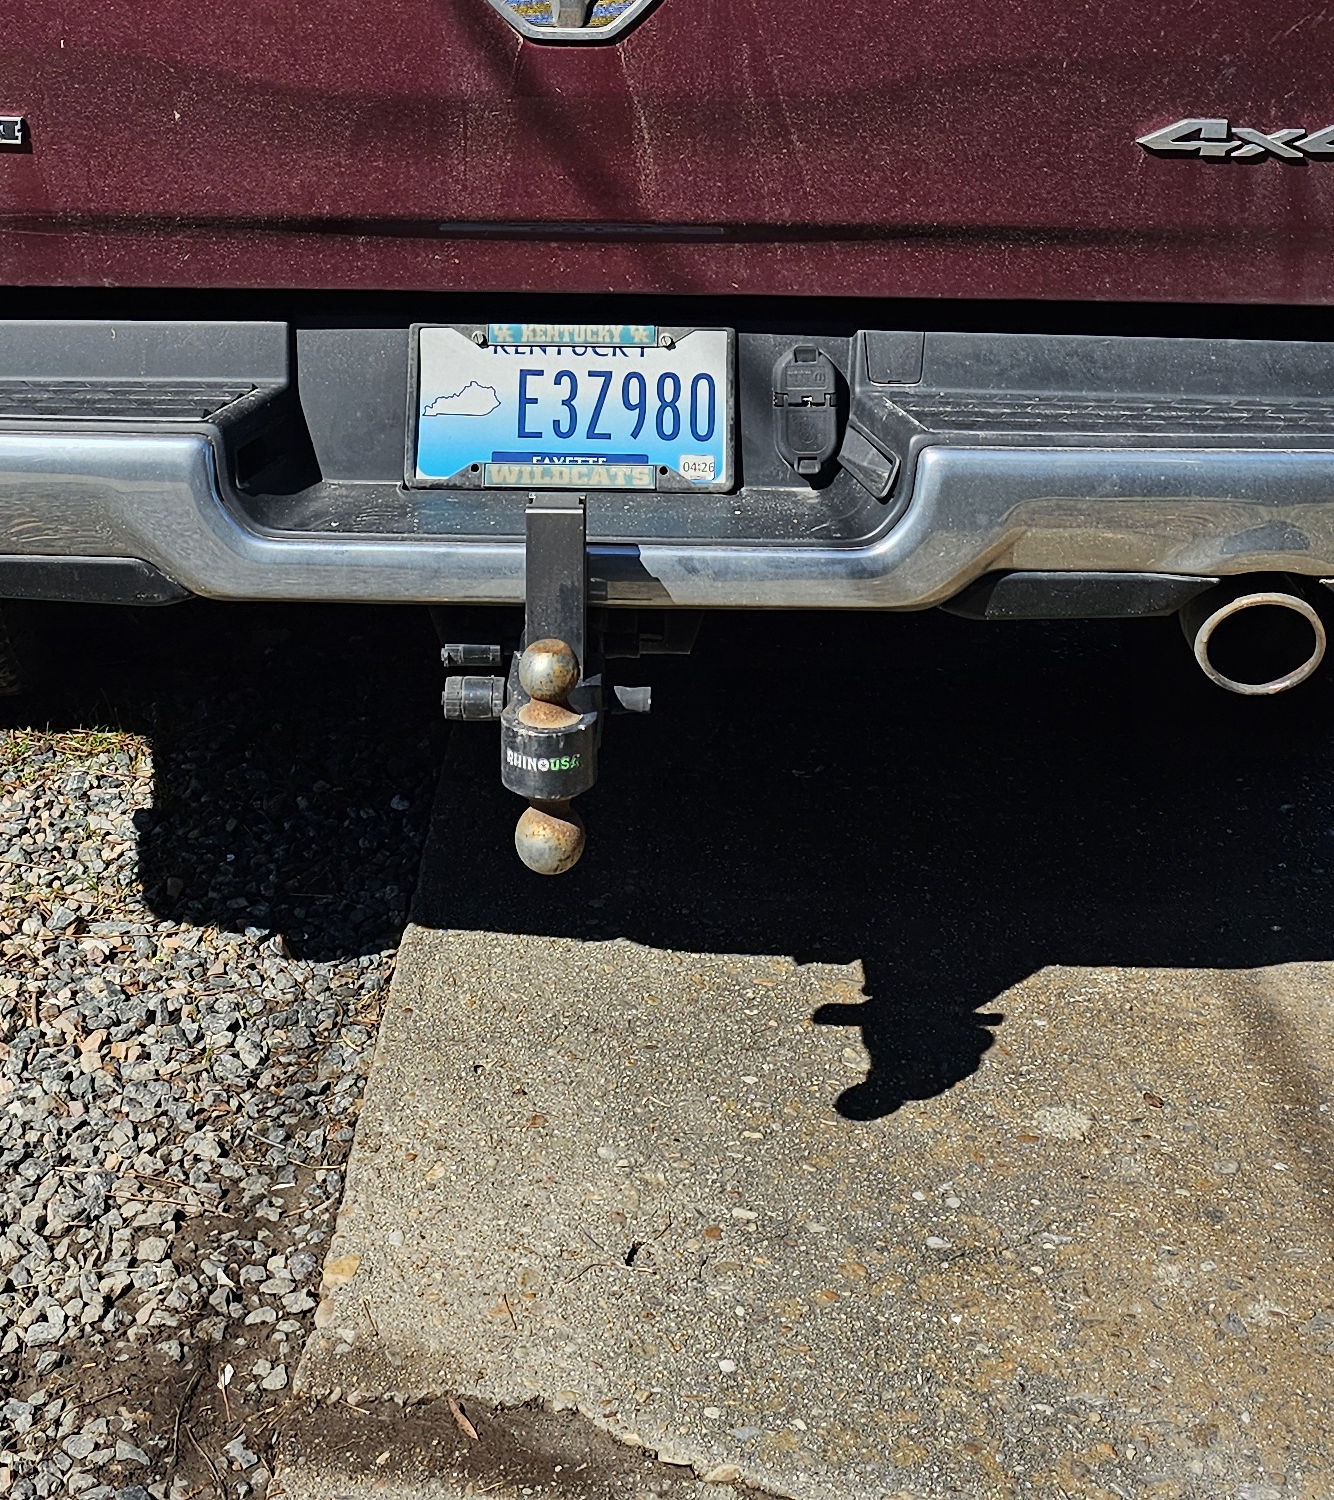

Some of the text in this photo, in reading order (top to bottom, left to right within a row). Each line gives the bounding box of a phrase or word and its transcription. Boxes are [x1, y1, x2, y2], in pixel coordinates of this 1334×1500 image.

[521, 325, 622, 343] KENTUCKY
[517, 368, 717, 442] E3Z980
[488, 465, 651, 486] WILDCATS
